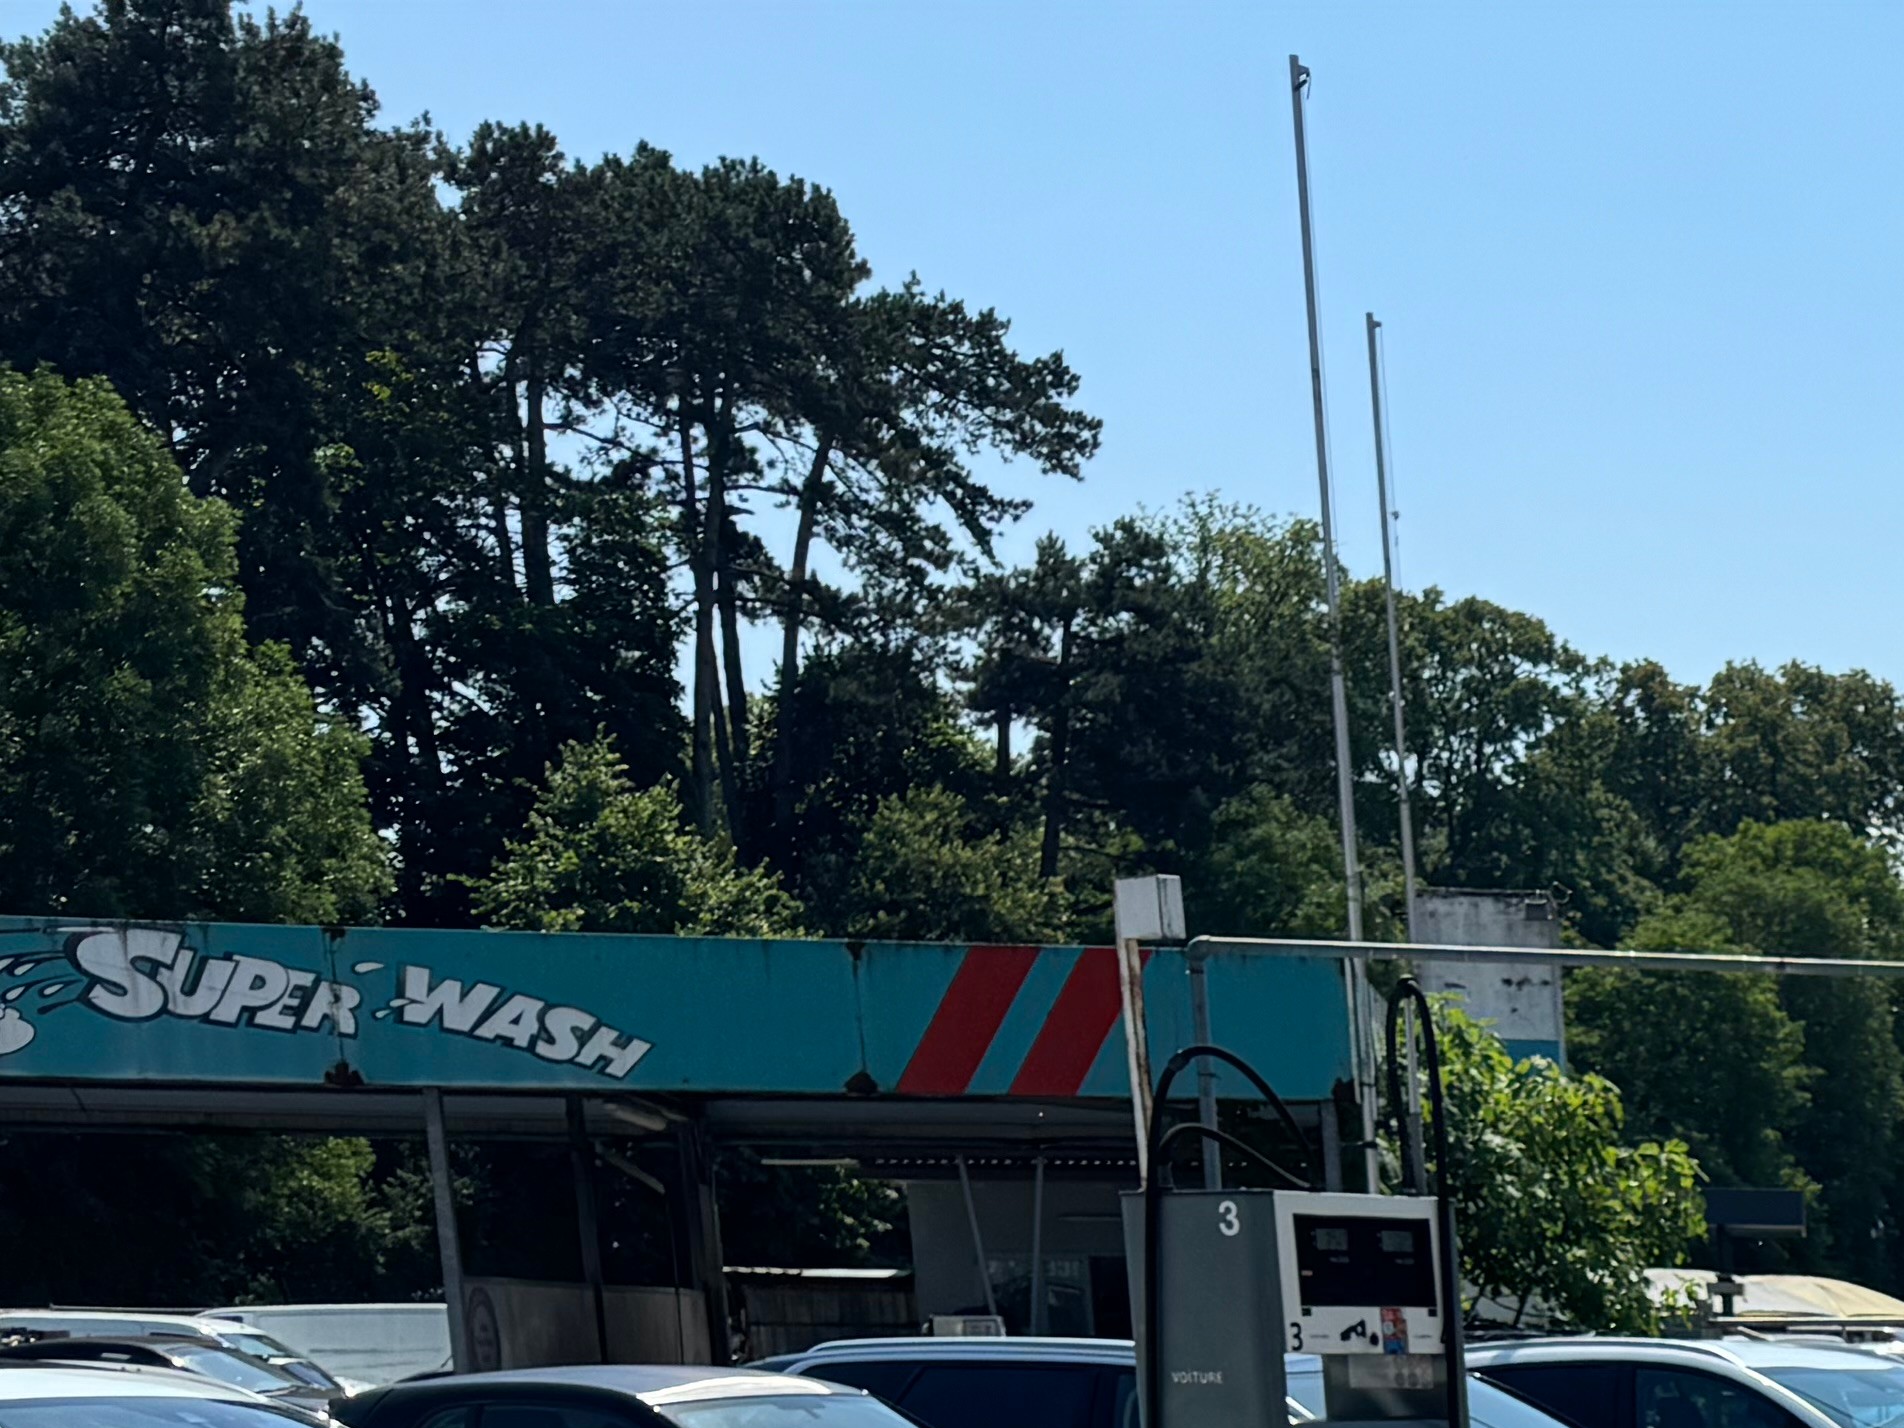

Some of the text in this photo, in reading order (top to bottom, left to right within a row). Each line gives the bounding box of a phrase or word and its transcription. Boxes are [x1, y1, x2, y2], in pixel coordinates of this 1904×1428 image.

[73, 927, 652, 1079] SUPER WASH
[1218, 1201, 1241, 1237] 3
[1288, 1321, 1304, 1353] 3
